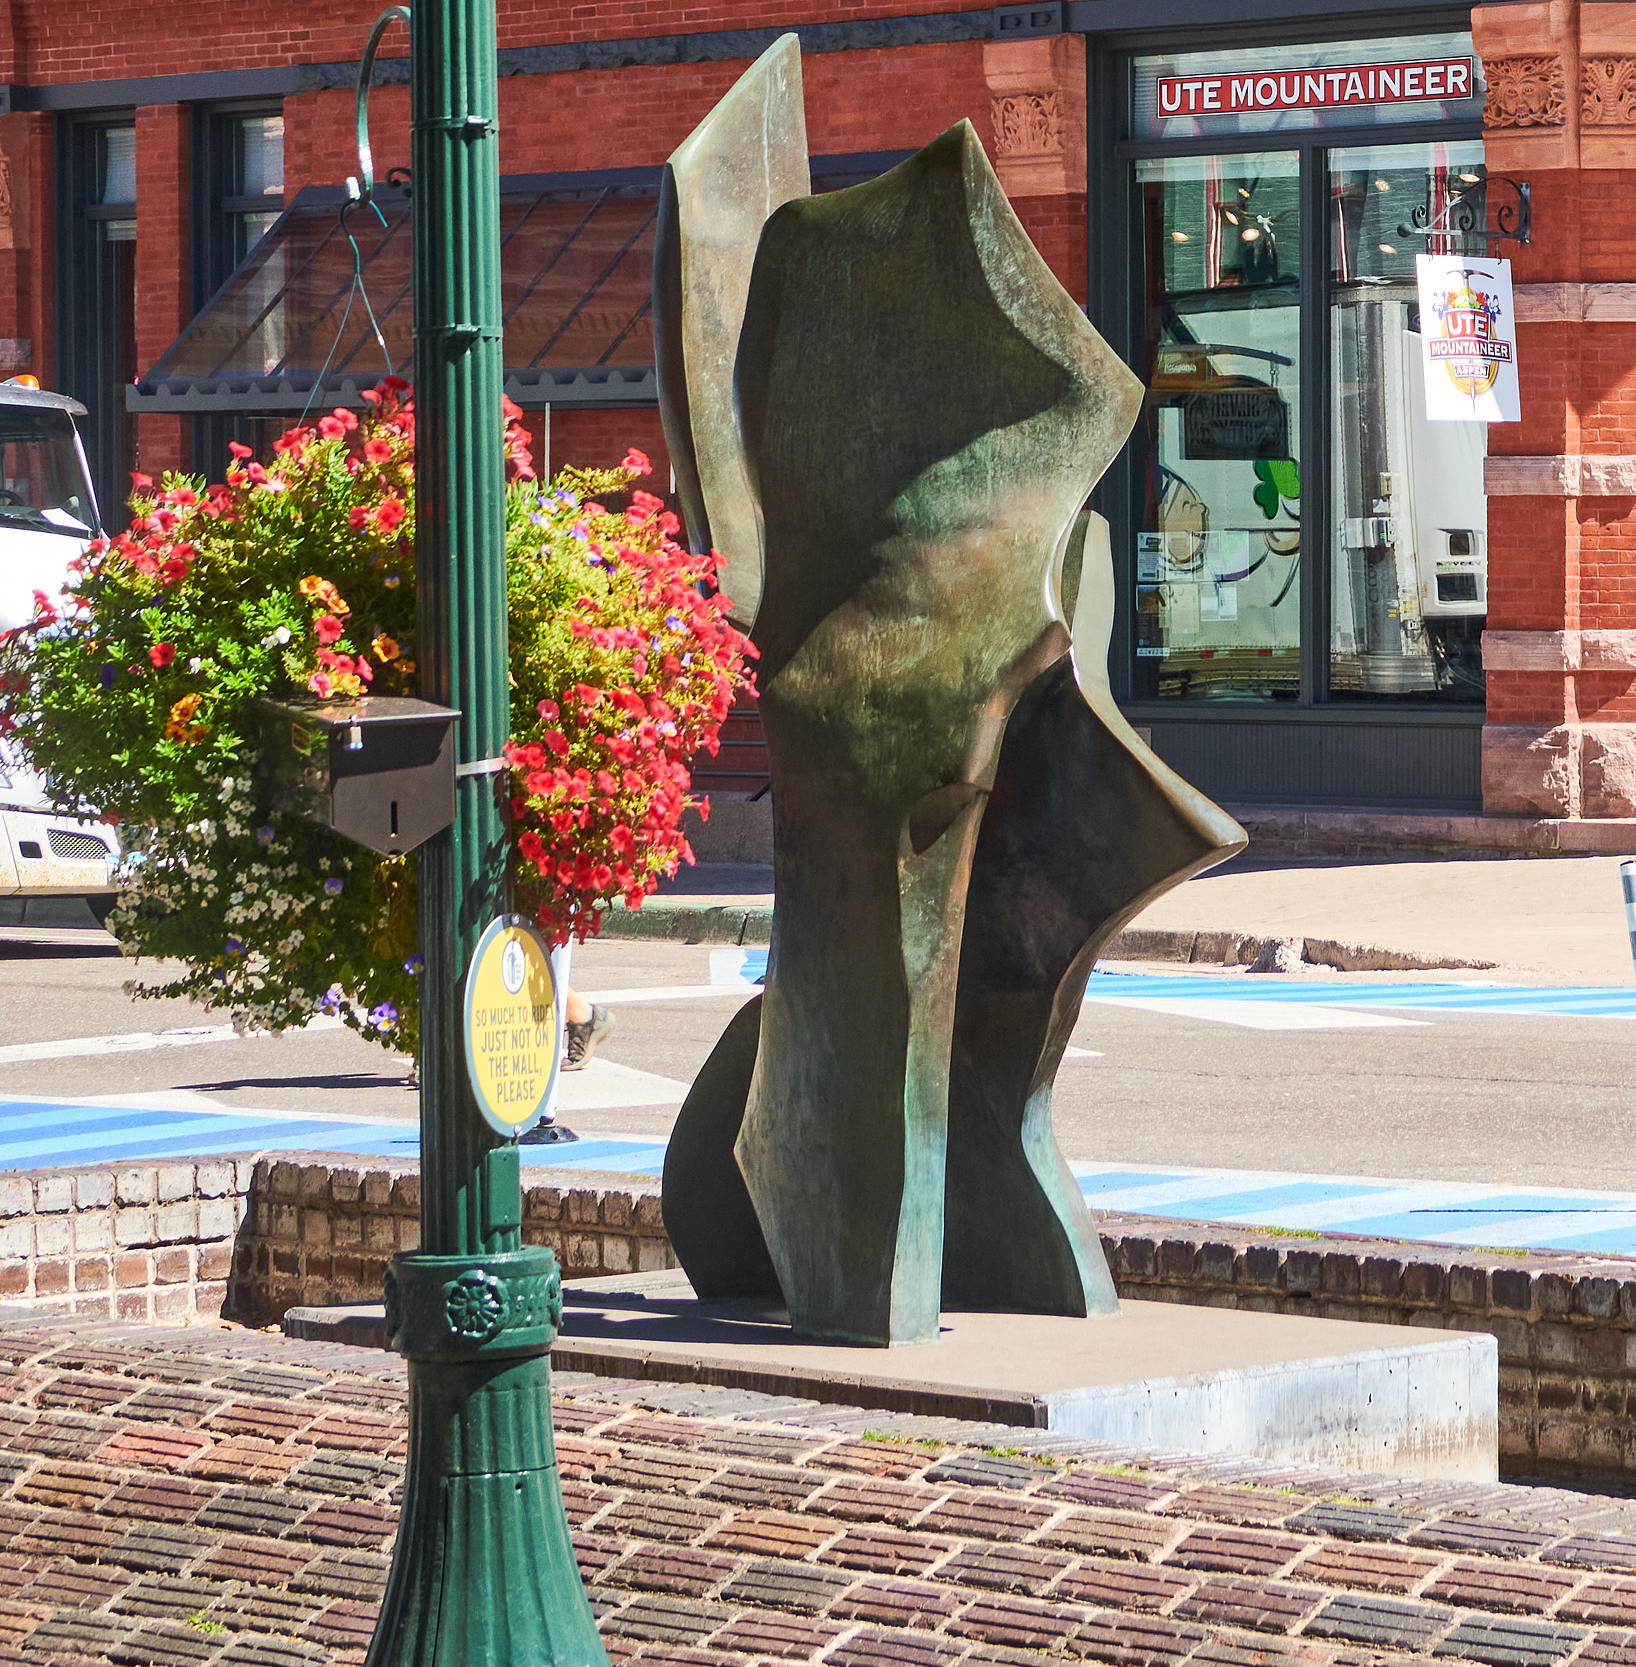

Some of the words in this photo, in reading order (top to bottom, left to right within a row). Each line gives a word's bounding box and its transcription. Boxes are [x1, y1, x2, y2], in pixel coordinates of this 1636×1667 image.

[1160, 79, 1222, 113] UTE
[1230, 63, 1468, 107] MOUNTAINEER
[1447, 313, 1488, 337] UTE
[1431, 340, 1509, 358] MOUNTAINEER
[1456, 365, 1487, 376] ASPEN
[476, 1010, 487, 1027] SO
[490, 1007, 515, 1025] MUCH
[518, 1005, 529, 1023] TO
[481, 1030, 507, 1053] JUST
[511, 1028, 531, 1050] NOT
[535, 1026, 549, 1047] ON
[489, 1055, 508, 1079] THE
[512, 1053, 543, 1077] MALL,
[496, 1079, 536, 1104] PLEASE
